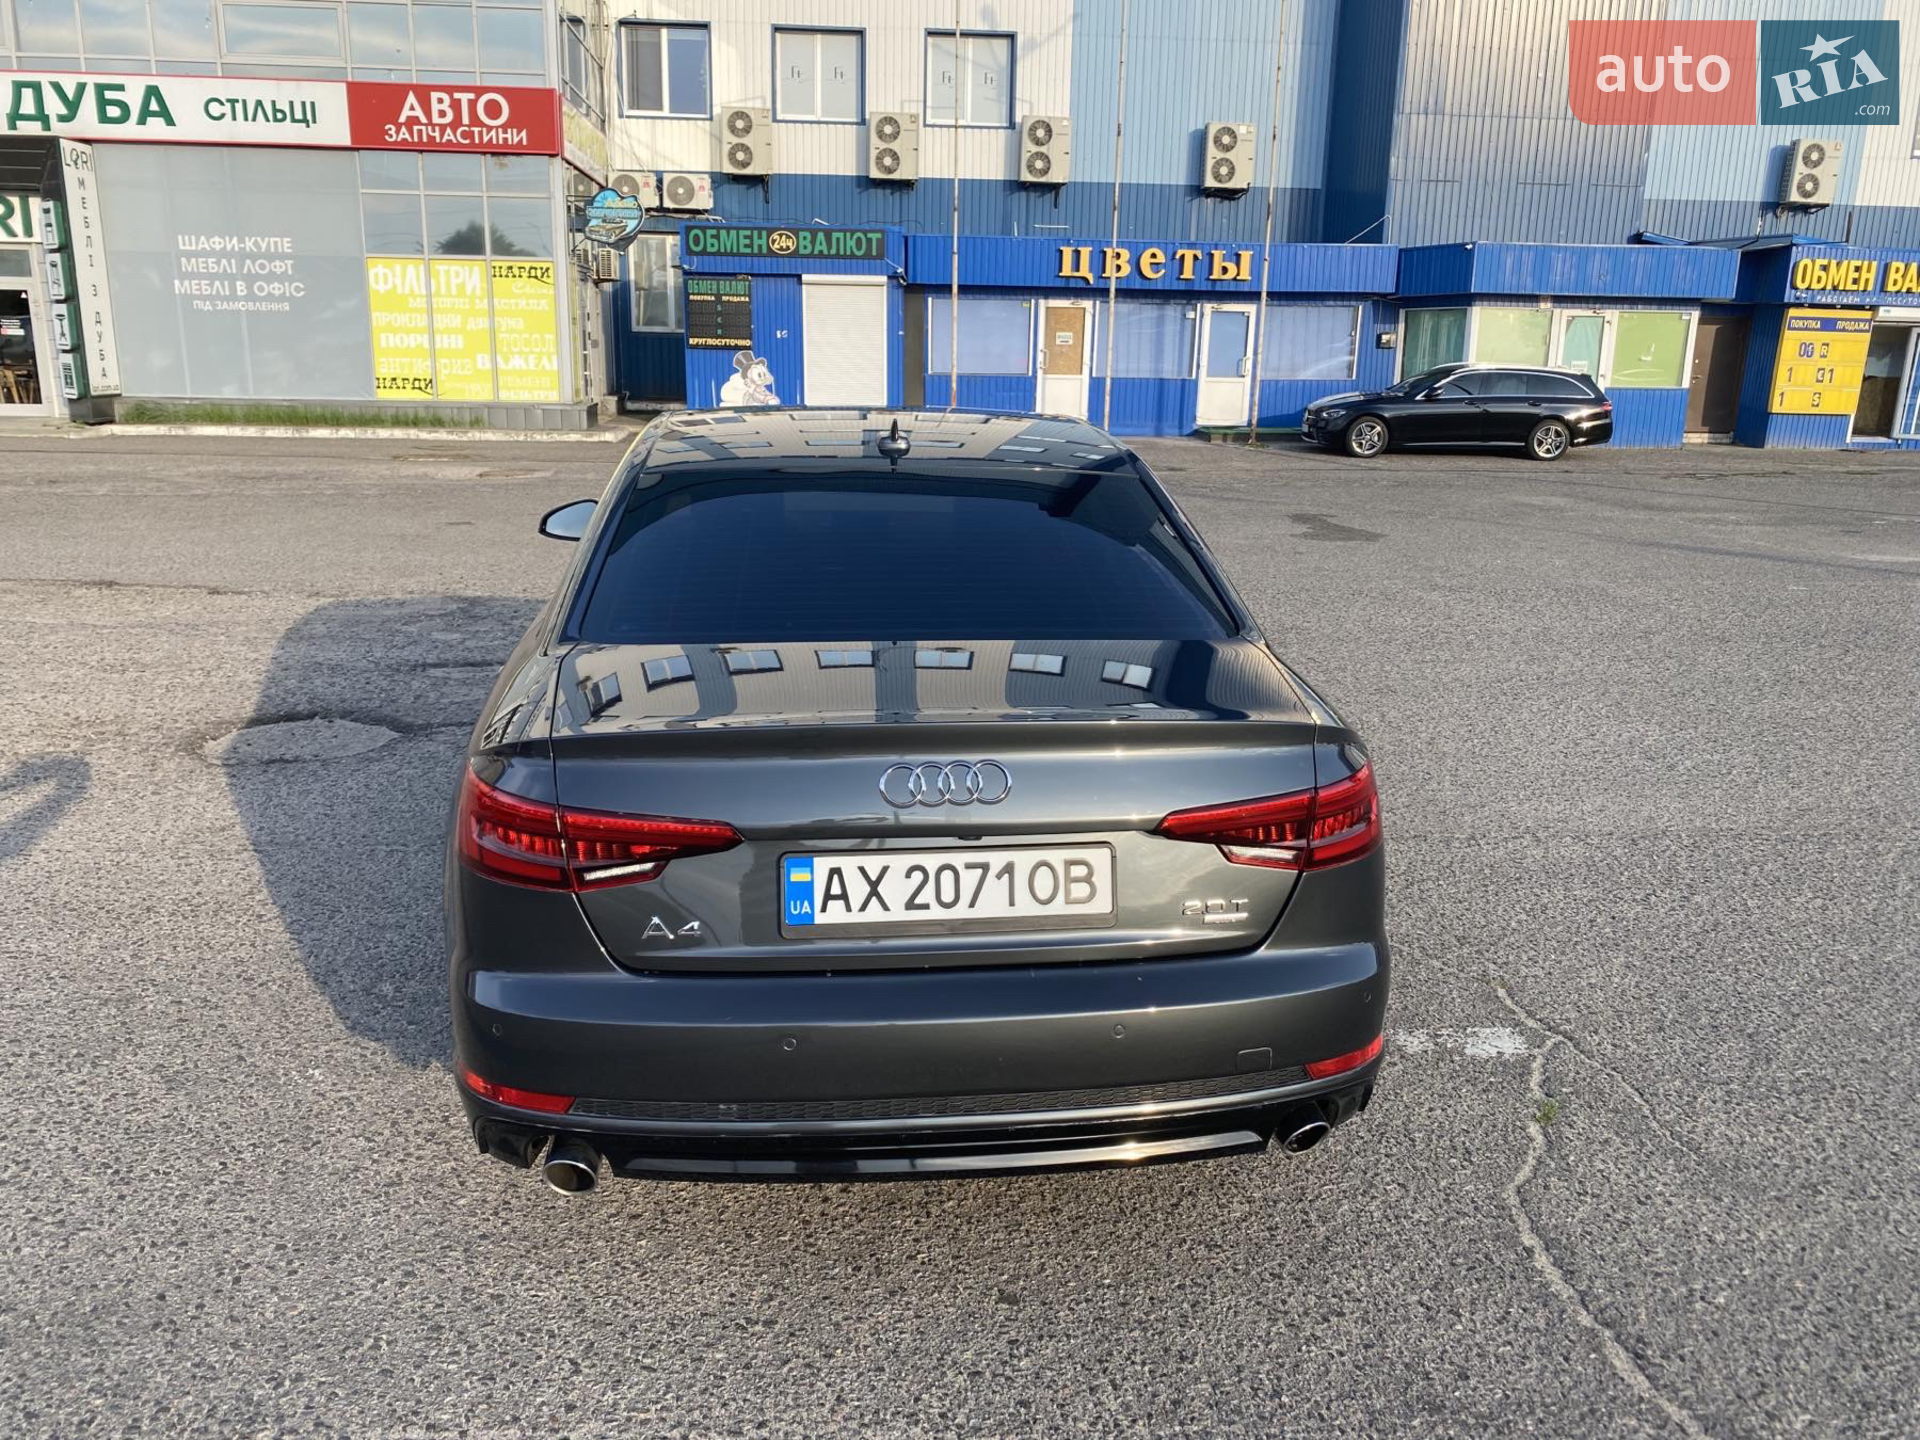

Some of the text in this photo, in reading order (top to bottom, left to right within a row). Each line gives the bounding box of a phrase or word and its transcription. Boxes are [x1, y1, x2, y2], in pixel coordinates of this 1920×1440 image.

[6, 80, 317, 131] ДУБА СТІЛЬЦІ
[397, 90, 510, 127] АВТО
[384, 124, 527, 146] ЗАПЧАСТИНИ
[177, 235, 292, 253] ШАФИ-КУПЕ
[688, 229, 767, 254] ОБМЕН
[798, 231, 882, 256] ВАЛЮТ
[180, 257, 295, 275] МЕБЛІ ЛОФТ
[491, 265, 555, 284] НАРДИ
[1795, 258, 1920, 293] ОБМЕН ВА
[173, 279, 306, 297] МЕБЛІ В ОФІС
[687, 280, 750, 295] ОБМЕН ВАЛЮТ
[192, 300, 290, 311] ПІД ЗАМОВЛЕННЯ
[1790, 319, 1869, 331] ПОКУПКА ПРОДАЖА
[688, 337, 751, 346] КРУГЛОСУТОЧНО
[819, 865, 892, 913] AX
[904, 861, 1015, 910] 2071
[790, 900, 812, 914] UA
[641, 916, 702, 938] A4
